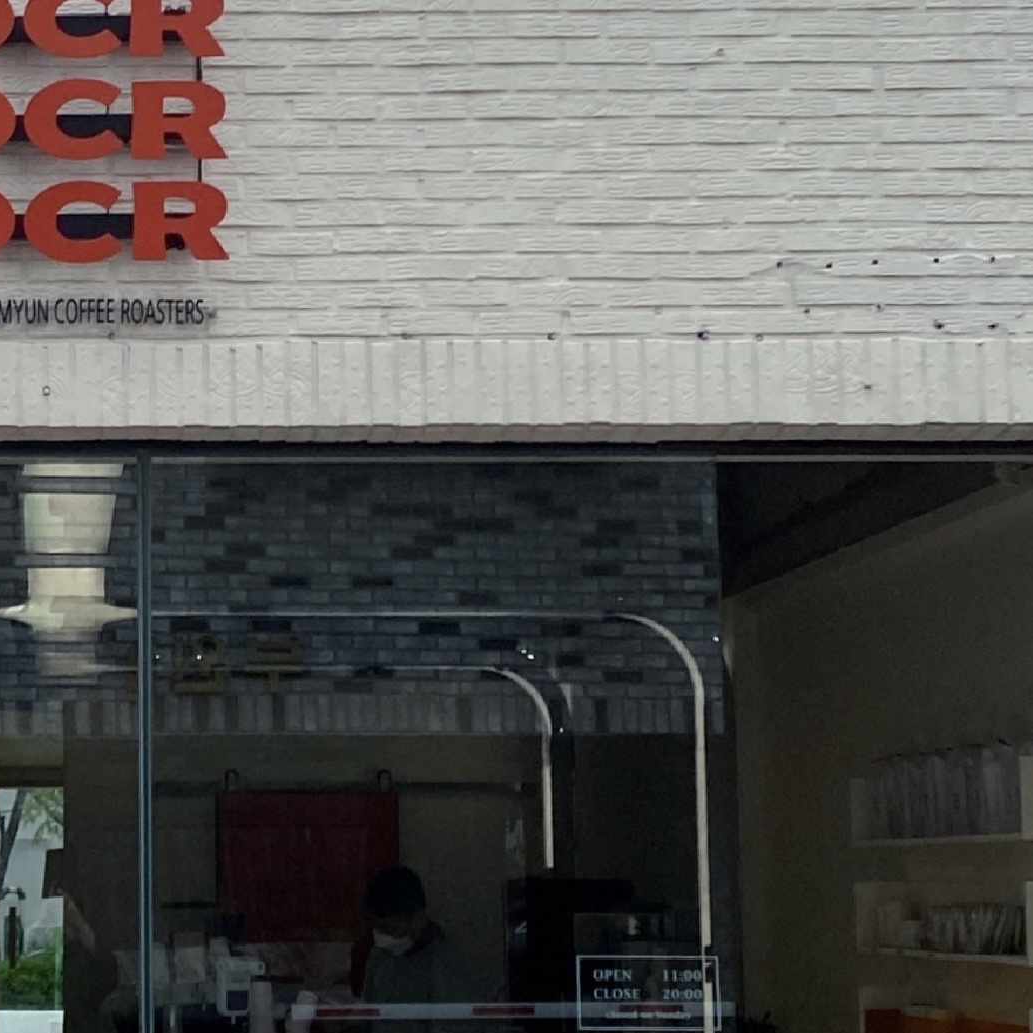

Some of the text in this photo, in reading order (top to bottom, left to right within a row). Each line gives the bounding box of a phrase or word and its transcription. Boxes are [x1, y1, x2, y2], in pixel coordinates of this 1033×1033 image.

[54, 298, 115, 325] COFFEE
[120, 298, 205, 325] ROASTERS
[593, 968, 703, 982] OPEN 11:00
[593, 987, 703, 1000] CLOSE 20:00
